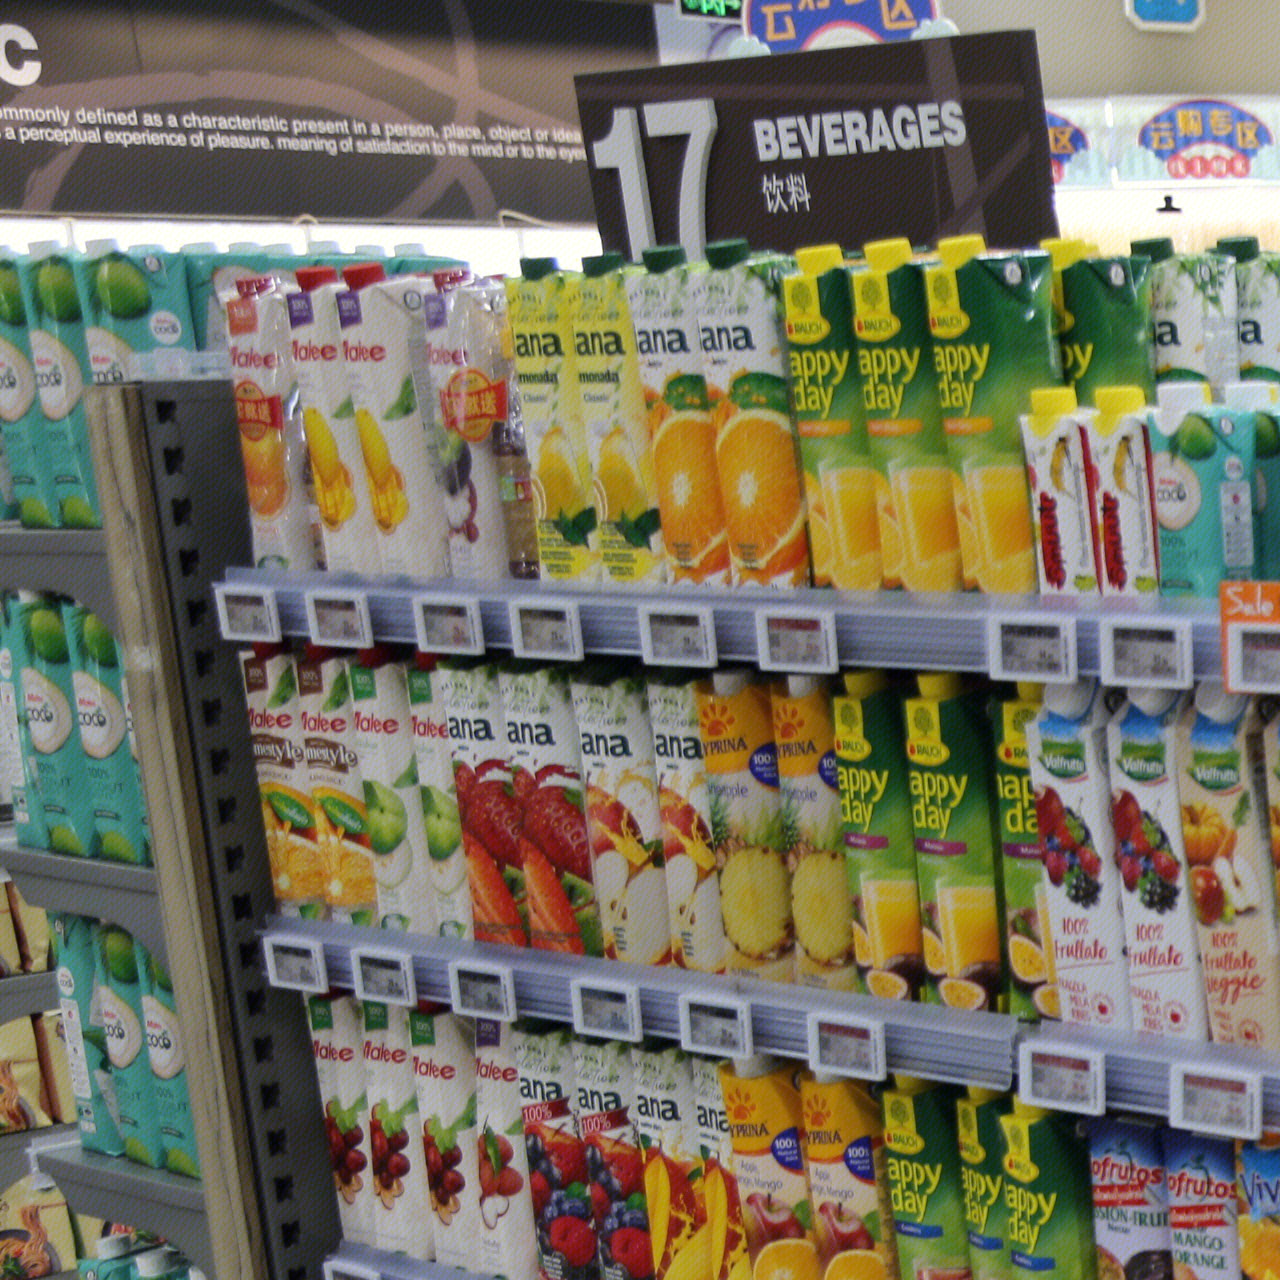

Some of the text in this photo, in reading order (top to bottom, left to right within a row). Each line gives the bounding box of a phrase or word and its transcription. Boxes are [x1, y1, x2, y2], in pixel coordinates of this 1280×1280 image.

[0, 105, 70, 126] mmonly
[75, 108, 138, 126] defined
[143, 113, 164, 128] as
[167, 114, 179, 128] a
[183, 112, 288, 132] characteristic
[292, 118, 349, 136] present
[352, 119, 367, 135] in
[371, 123, 381, 136] a
[490, 124, 533, 144] object
[535, 129, 549, 142] or
[552, 127, 583, 144] idea
[754, 100, 967, 162] BEVERAGES
[5, 127, 16, 140] a
[20, 126, 101, 146] perceptual
[104, 130, 187, 148] experience
[190, 131, 204, 147] of
[278, 136, 338, 156] meaning
[340, 136, 353, 153] of
[356, 137, 430, 155] satisfaction
[433, 141, 446, 155] to
[449, 140, 469, 156] the
[472, 142, 504, 158] mind
[505, 146, 518, 159] or
[520, 144, 533, 160] to
[536, 144, 557, 161] the
[593, 98, 718, 262] 17
[762, 173, 811, 214] 饮料
[789, 348, 850, 386] appy
[858, 346, 921, 385] appy
[933, 342, 990, 383] appy
[1225, 584, 1275, 617] Sale
[448, 715, 495, 742] ana
[507, 718, 556, 746] ana
[581, 731, 632, 758] ana
[702, 737, 748, 756] YPRINA
[776, 740, 819, 759] YPRINA
[838, 766, 890, 803] appy
[909, 770, 968, 808] appy
[841, 797, 875, 833] day
[912, 804, 953, 840] day
[519, 1077, 562, 1103] ana
[523, 1104, 553, 1122] 100%
[582, 1115, 612, 1134] 100%
[729, 1121, 769, 1139] YPRINA
[804, 1129, 843, 1146] YPRINA
[1091, 1156, 1164, 1186] ofrutos
[1168, 1170, 1238, 1200] ofrutos
[1174, 1250, 1228, 1270] ORANGE
